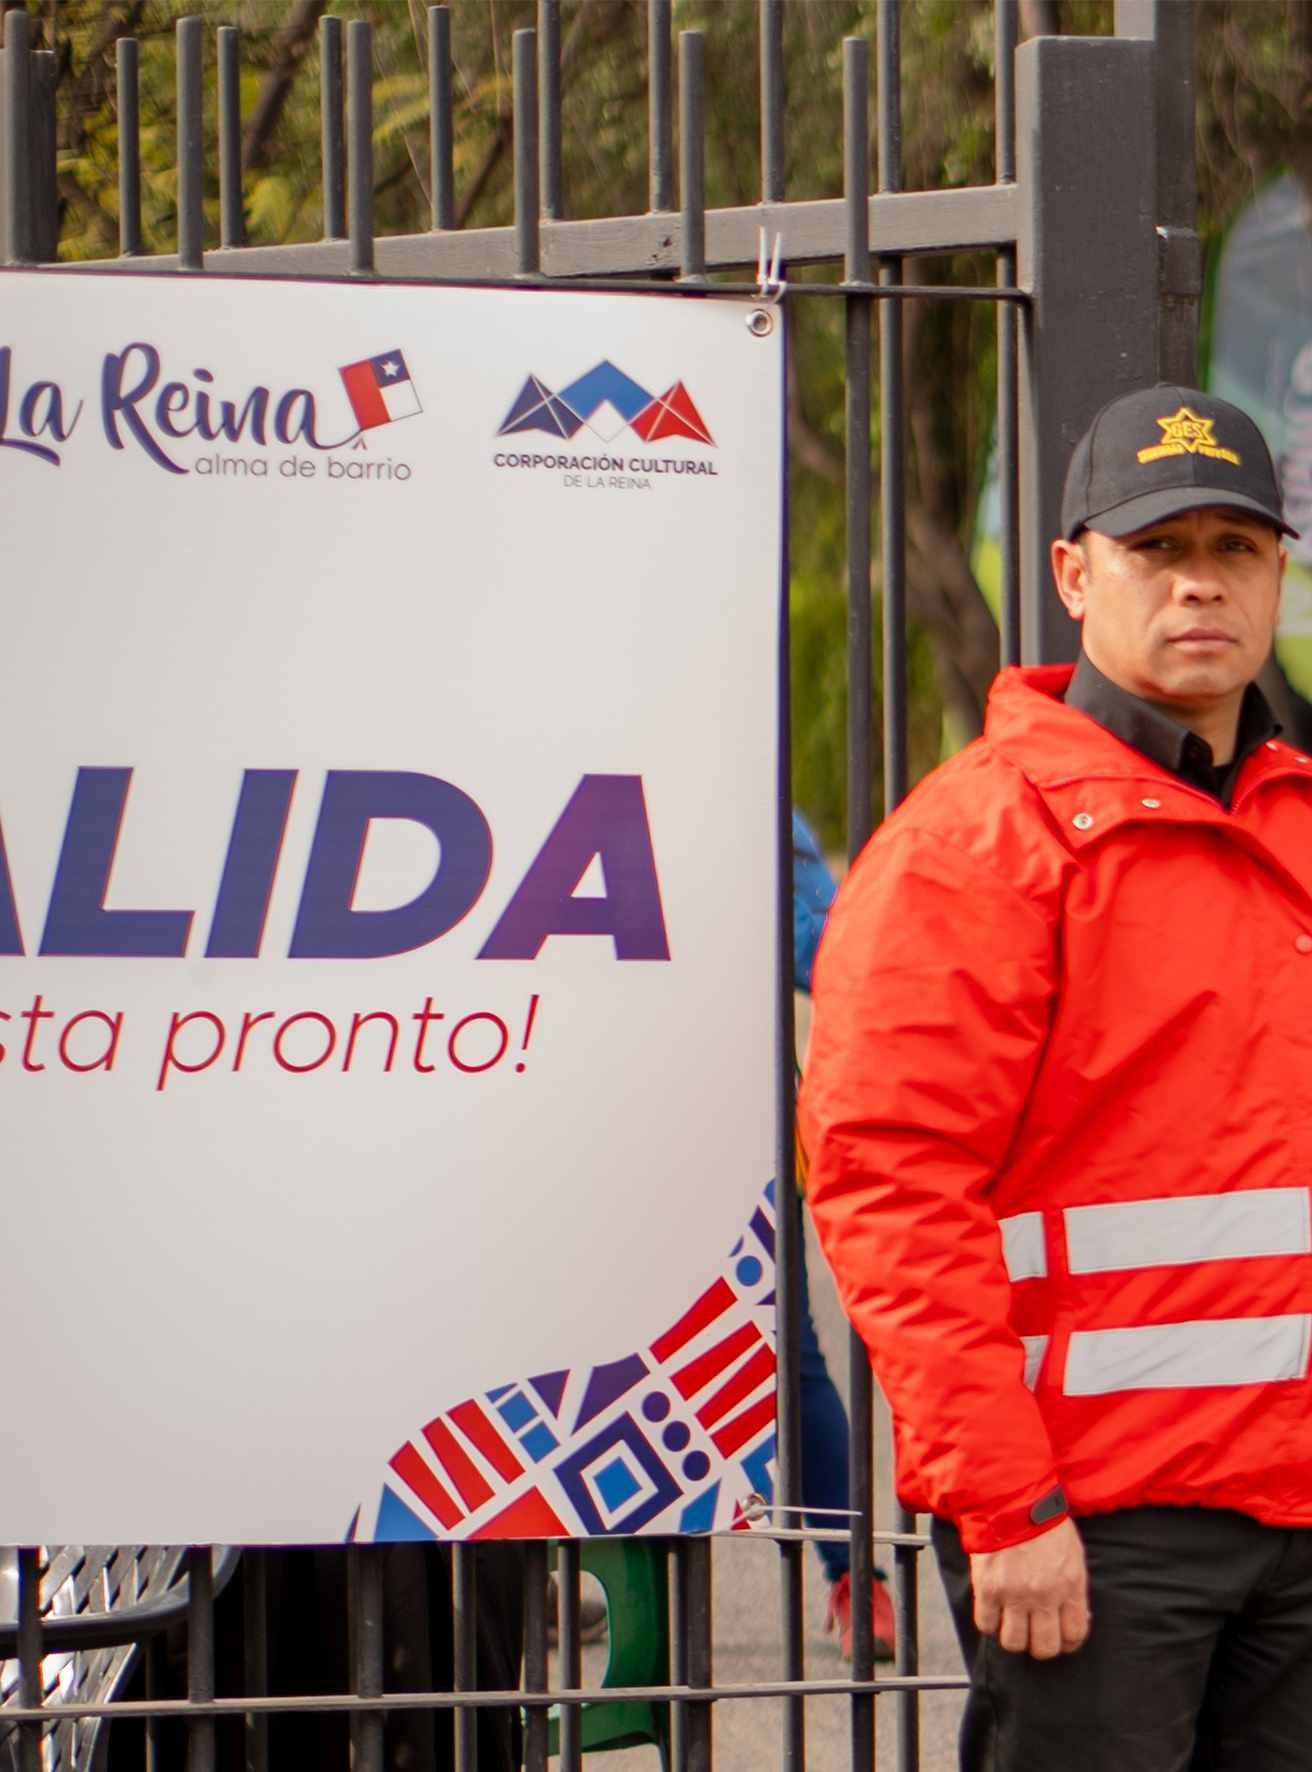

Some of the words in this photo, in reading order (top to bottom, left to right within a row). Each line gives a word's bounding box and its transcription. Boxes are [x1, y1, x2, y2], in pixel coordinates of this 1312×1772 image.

[0, 346, 84, 467] La
[101, 342, 357, 475] Reina
[1170, 421, 1203, 438] GES
[195, 453, 268, 476] alma
[279, 454, 317, 478] de
[327, 456, 412, 481] barrio
[493, 452, 625, 472] CORPORACIÓN
[629, 457, 718, 476] CULTURAL
[563, 474, 582, 488] DE
[587, 475, 605, 489] LA
[609, 476, 652, 490] REINA
[0, 766, 671, 961] LIDA
[156, 994, 540, 1092] pronto!
